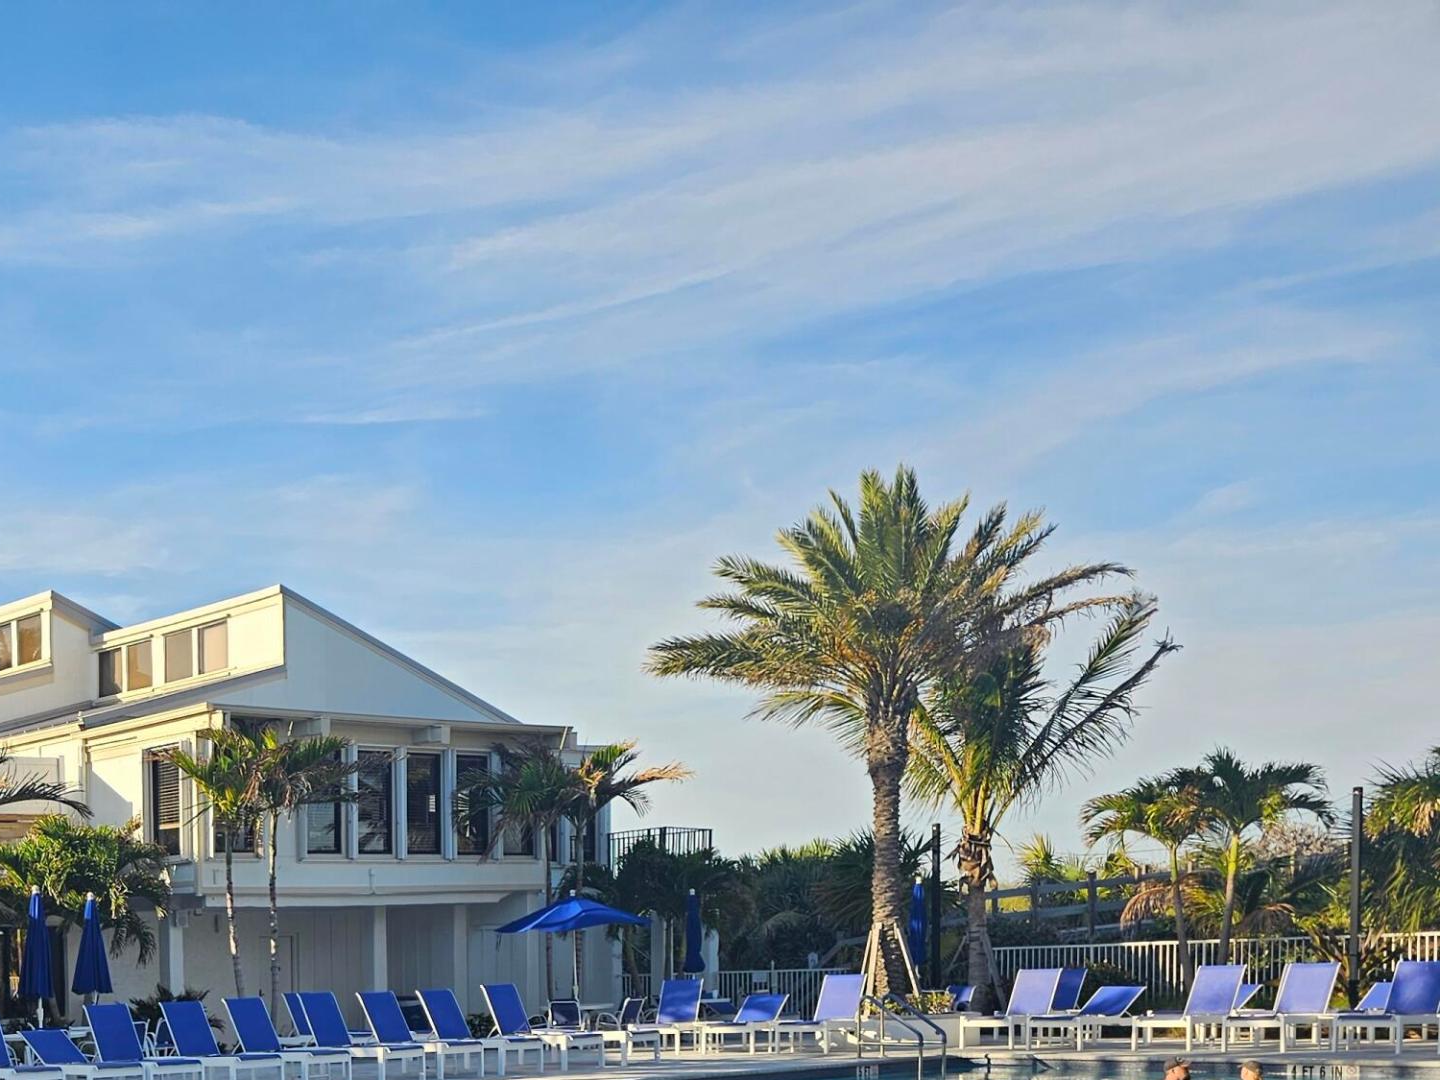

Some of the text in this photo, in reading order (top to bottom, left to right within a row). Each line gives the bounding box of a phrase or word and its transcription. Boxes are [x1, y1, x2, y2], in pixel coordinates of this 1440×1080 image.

[1291, 1065, 1343, 1080] 4 FT 6 IN
